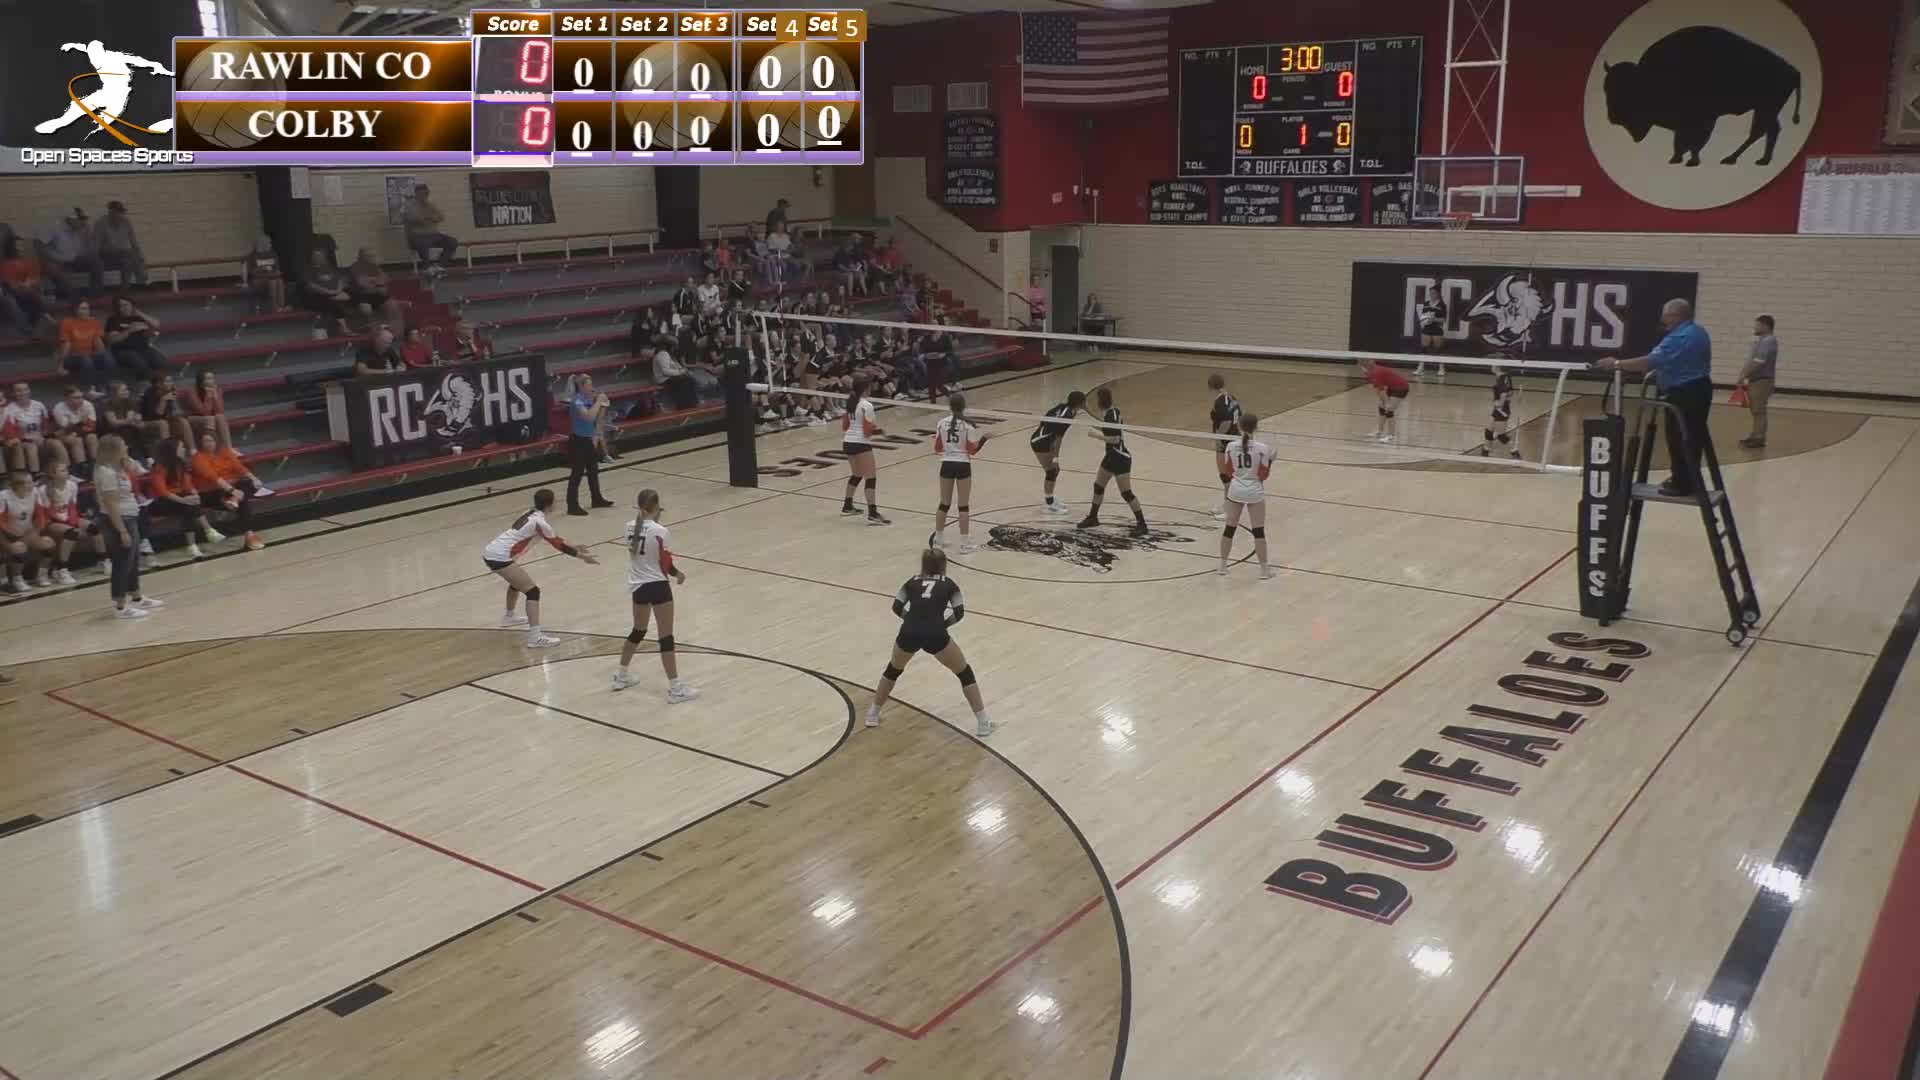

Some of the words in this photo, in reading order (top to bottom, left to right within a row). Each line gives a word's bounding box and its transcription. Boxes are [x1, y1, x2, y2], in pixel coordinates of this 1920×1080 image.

[1240, 65, 1264, 76] HOME
[1281, 46, 1322, 71] 3:00
[1324, 61, 1352, 73] GUEST
[1253, 75, 1267, 100] 0
[1338, 71, 1353, 97] 0
[1240, 124, 1252, 148] 0
[1300, 124, 1307, 146] 1
[1337, 122, 1351, 147] 0
[1255, 159, 1328, 175] BUFFALOES
[1319, 183, 1359, 196] VOLLEYBALL
[1550, 281, 1628, 349] HS
[368, 383, 427, 447] RC
[480, 367, 533, 426] HS
[946, 428, 960, 443] 15
[1588, 436, 1611, 597] BUFFS
[921, 580, 937, 599] 7
[1263, 631, 1652, 925] BUFFALOES
